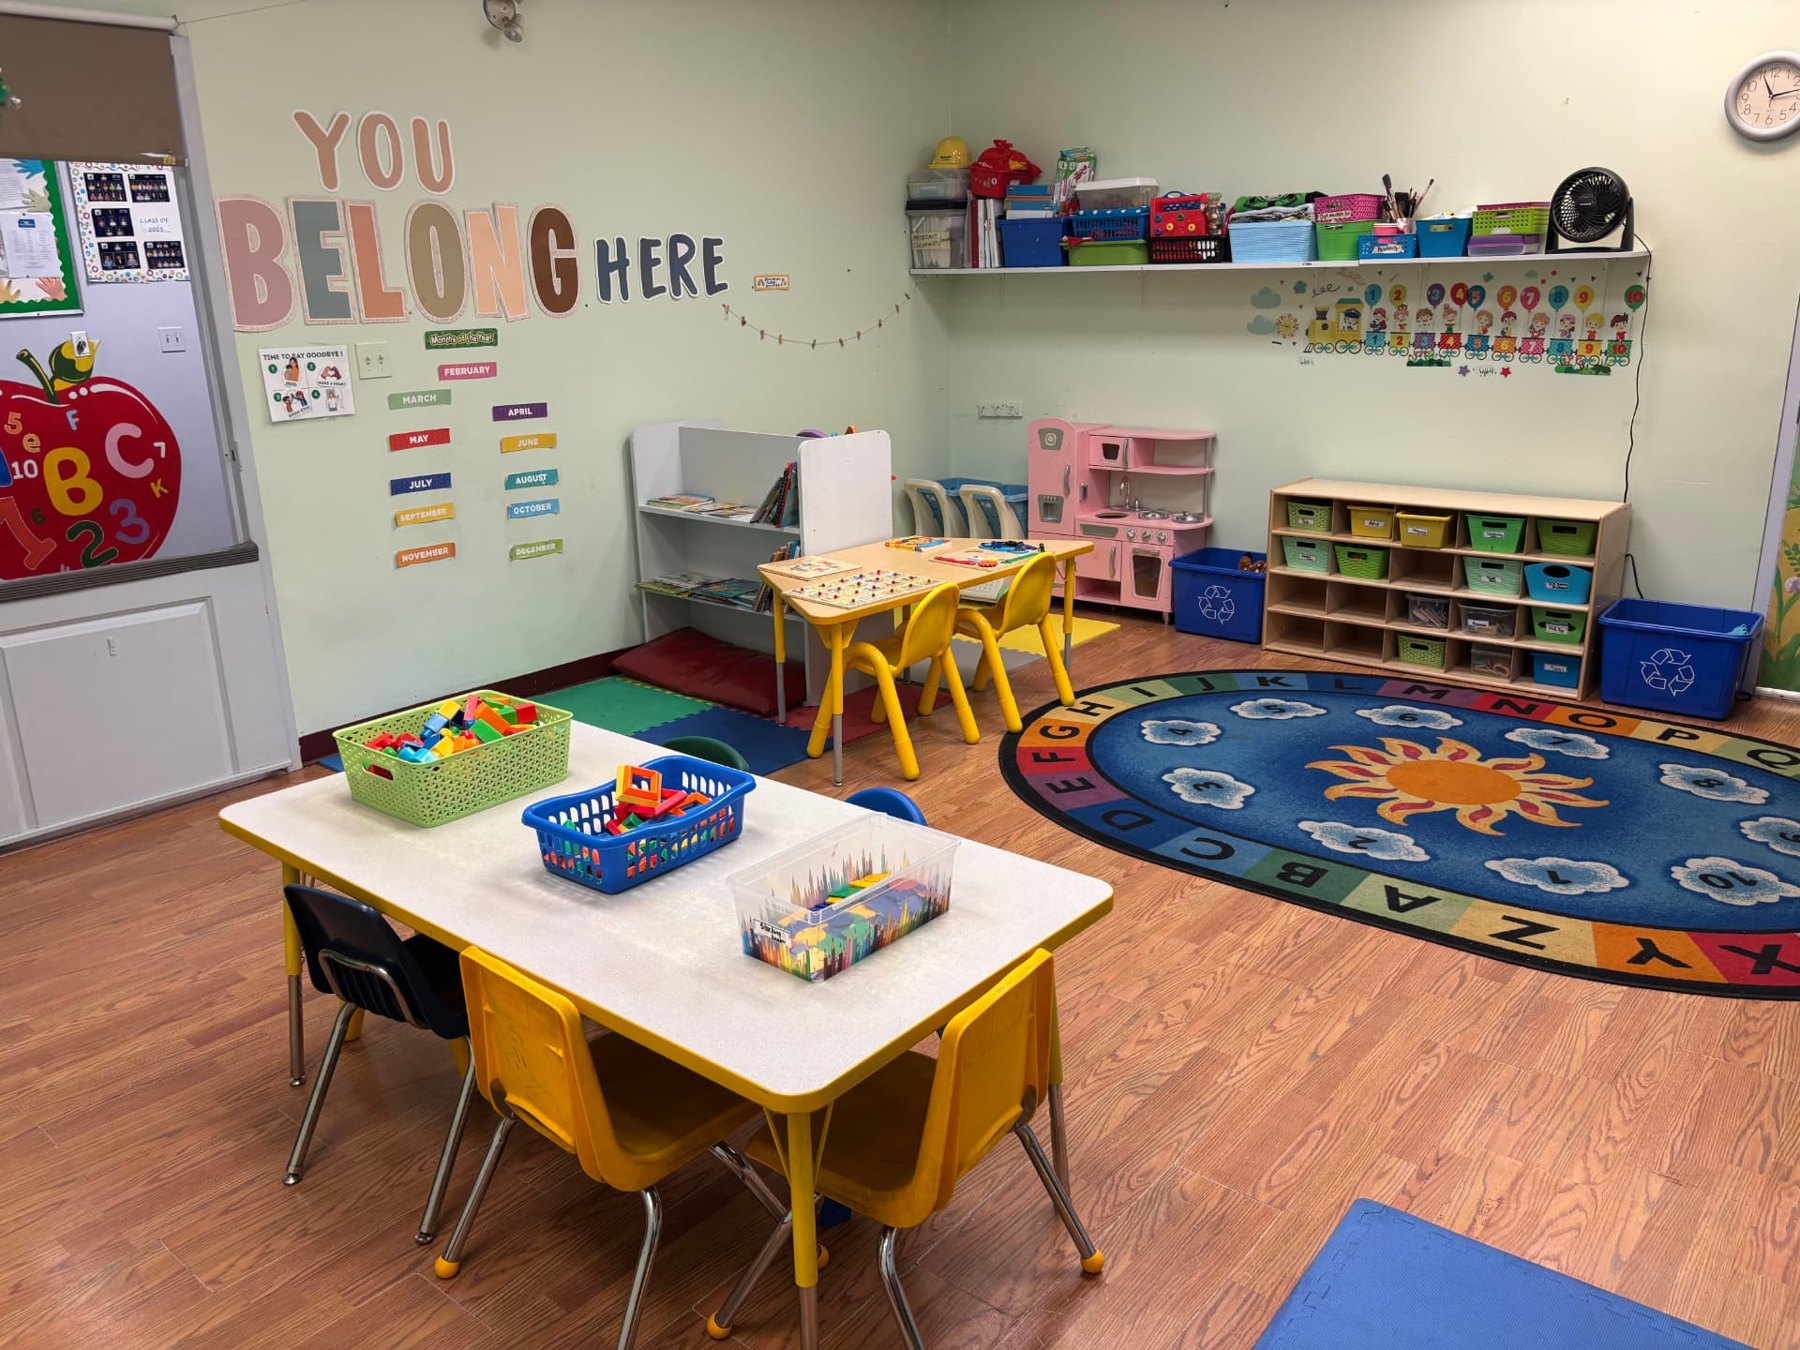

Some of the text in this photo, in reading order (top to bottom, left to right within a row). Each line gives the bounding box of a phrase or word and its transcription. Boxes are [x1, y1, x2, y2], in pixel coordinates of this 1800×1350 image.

[1771, 66, 1781, 78] 12
[1747, 80, 1757, 92] 10
[1741, 93, 1749, 104] 9
[1743, 103, 1751, 116] 8
[1789, 102, 1797, 113] 4
[1754, 113, 1760, 124] 7
[1765, 114, 1773, 125] 6
[1779, 110, 1787, 121] 5
[293, 110, 455, 194] YOU
[215, 194, 581, 332] BELONG
[596, 233, 729, 304] HERE
[1394, 289, 1401, 301] 2
[1432, 288, 1440, 299] 3
[1456, 287, 1464, 300] 4
[1503, 290, 1511, 302] 6
[1526, 291, 1535, 304] 7
[1554, 291, 1562, 302] 8
[1579, 291, 1588, 303] 9
[1627, 290, 1644, 302] 10
[431, 334, 457, 345] Months
[458, 334, 466, 343] of
[467, 333, 478, 343] the
[1397, 336, 1403, 346] 2
[1422, 336, 1429, 346] 3
[1446, 336, 1454, 346] 4
[1500, 340, 1508, 350] 6
[1528, 340, 1536, 351] 7
[1586, 343, 1594, 353] 9
[1612, 343, 1627, 354] 10
[306, 351, 339, 359] GOODBYE
[444, 366, 490, 376] FEBRUARY
[403, 394, 437, 405] MARCH
[508, 408, 533, 417] APRIL
[4, 411, 23, 435] 5
[66, 409, 80, 431] F
[22, 433, 41, 453] e
[409, 434, 430, 444] MAY
[517, 438, 539, 447] JUNE
[105, 422, 154, 479] C
[153, 442, 166, 458] 7
[12, 459, 39, 479] 10
[43, 447, 103, 516] B
[409, 479, 432, 489] JULY
[515, 473, 548, 485] AUGUST
[150, 478, 170, 498] K
[400, 508, 448, 522] SEPTEMBER
[513, 503, 552, 515] OCTOBER
[31, 508, 46, 525] 6
[109, 498, 150, 545] 3
[66, 520, 118, 568] 2
[516, 543, 555, 556] DECEMBER
[402, 547, 449, 562] NOVEMBER
[1197, 677, 1217, 691] J
[1255, 675, 1294, 688] K
[1334, 678, 1365, 690] L
[1130, 686, 1158, 698] I
[1402, 685, 1451, 699] M
[1065, 700, 1114, 717] H
[1263, 704, 1287, 714] 5
[1491, 698, 1538, 714] N
[1398, 713, 1418, 722] 6
[1568, 713, 1617, 728] O
[1039, 724, 1081, 740] G
[1168, 727, 1193, 737] 4
[1656, 728, 1700, 742] P
[1548, 736, 1573, 746] 7
[1032, 751, 1076, 764] F
[1045, 776, 1096, 795] E
[1192, 781, 1224, 793] 3
[1692, 778, 1725, 789] 8
[1101, 809, 1156, 832] D
[1180, 837, 1235, 861] C
[1348, 836, 1378, 850] 2
[1275, 861, 1329, 888] B
[1547, 870, 1573, 885] 1
[1698, 871, 1760, 891] 10
[1384, 884, 1441, 914] A
[1488, 914, 1561, 950] Z
[1625, 937, 1693, 969] Y
